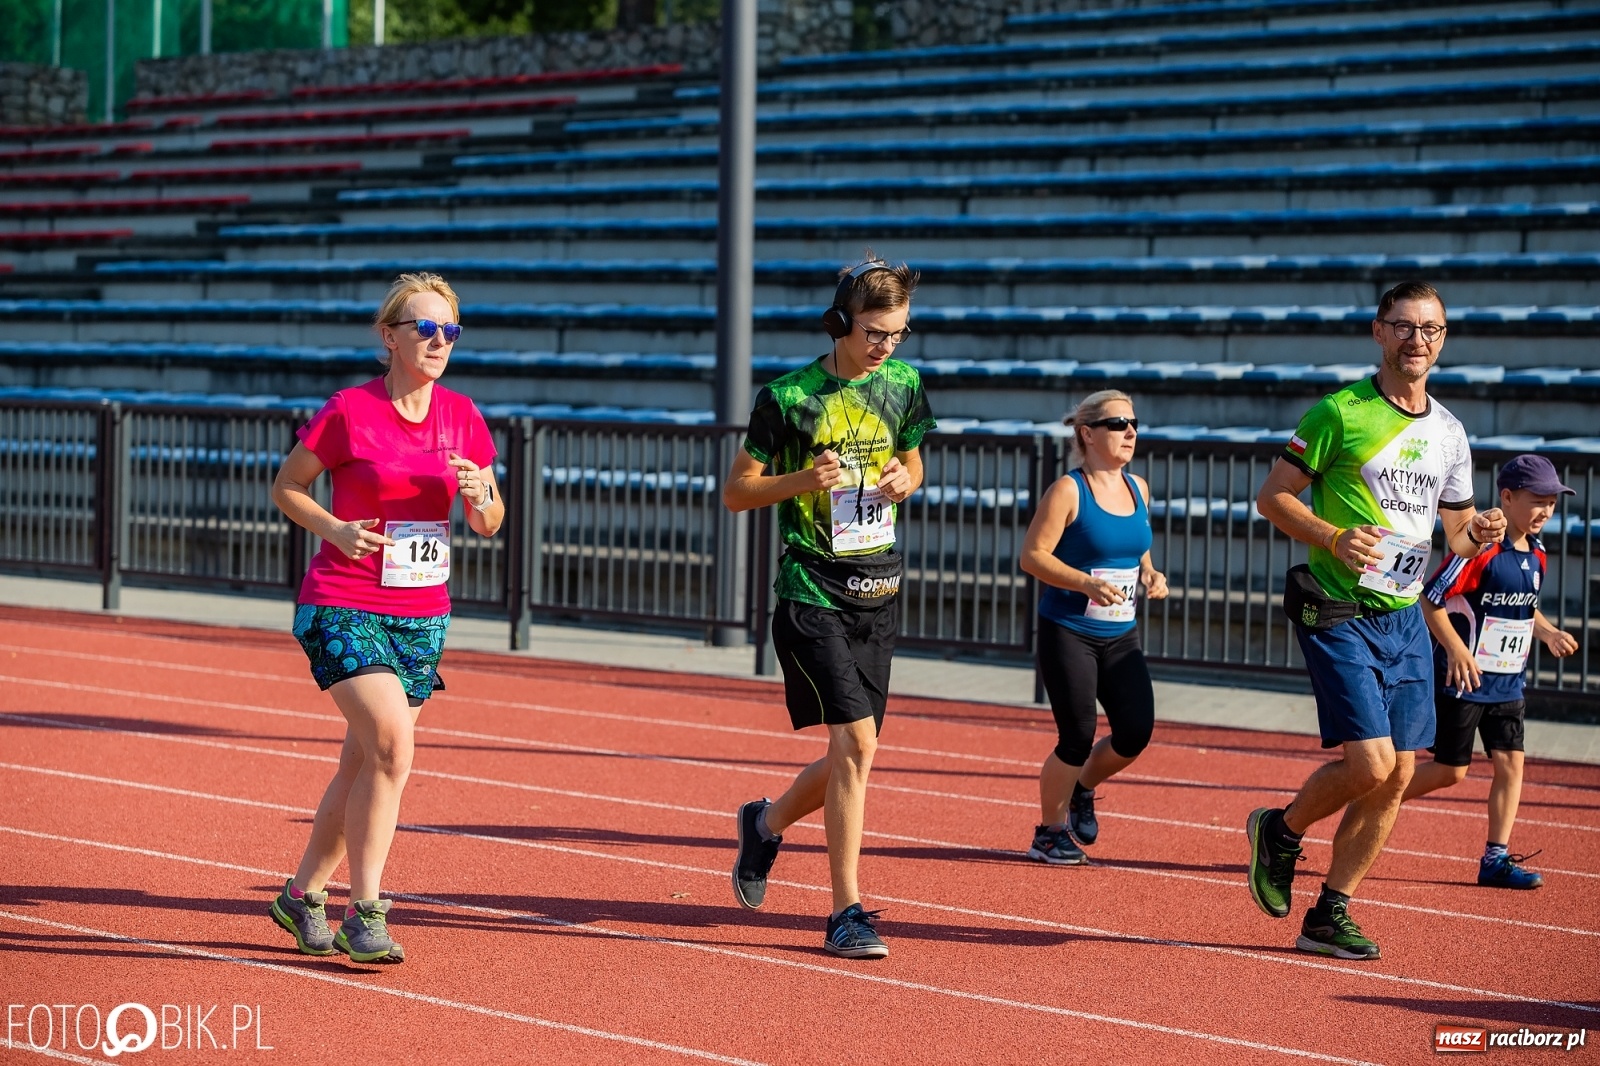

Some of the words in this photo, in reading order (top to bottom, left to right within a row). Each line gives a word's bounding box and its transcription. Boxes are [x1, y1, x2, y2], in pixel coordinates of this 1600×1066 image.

[1377, 467, 1438, 489] AKTYWNI
[855, 502, 883, 526] 130
[409, 540, 438, 563] 126
[1500, 635, 1524, 654] 141
